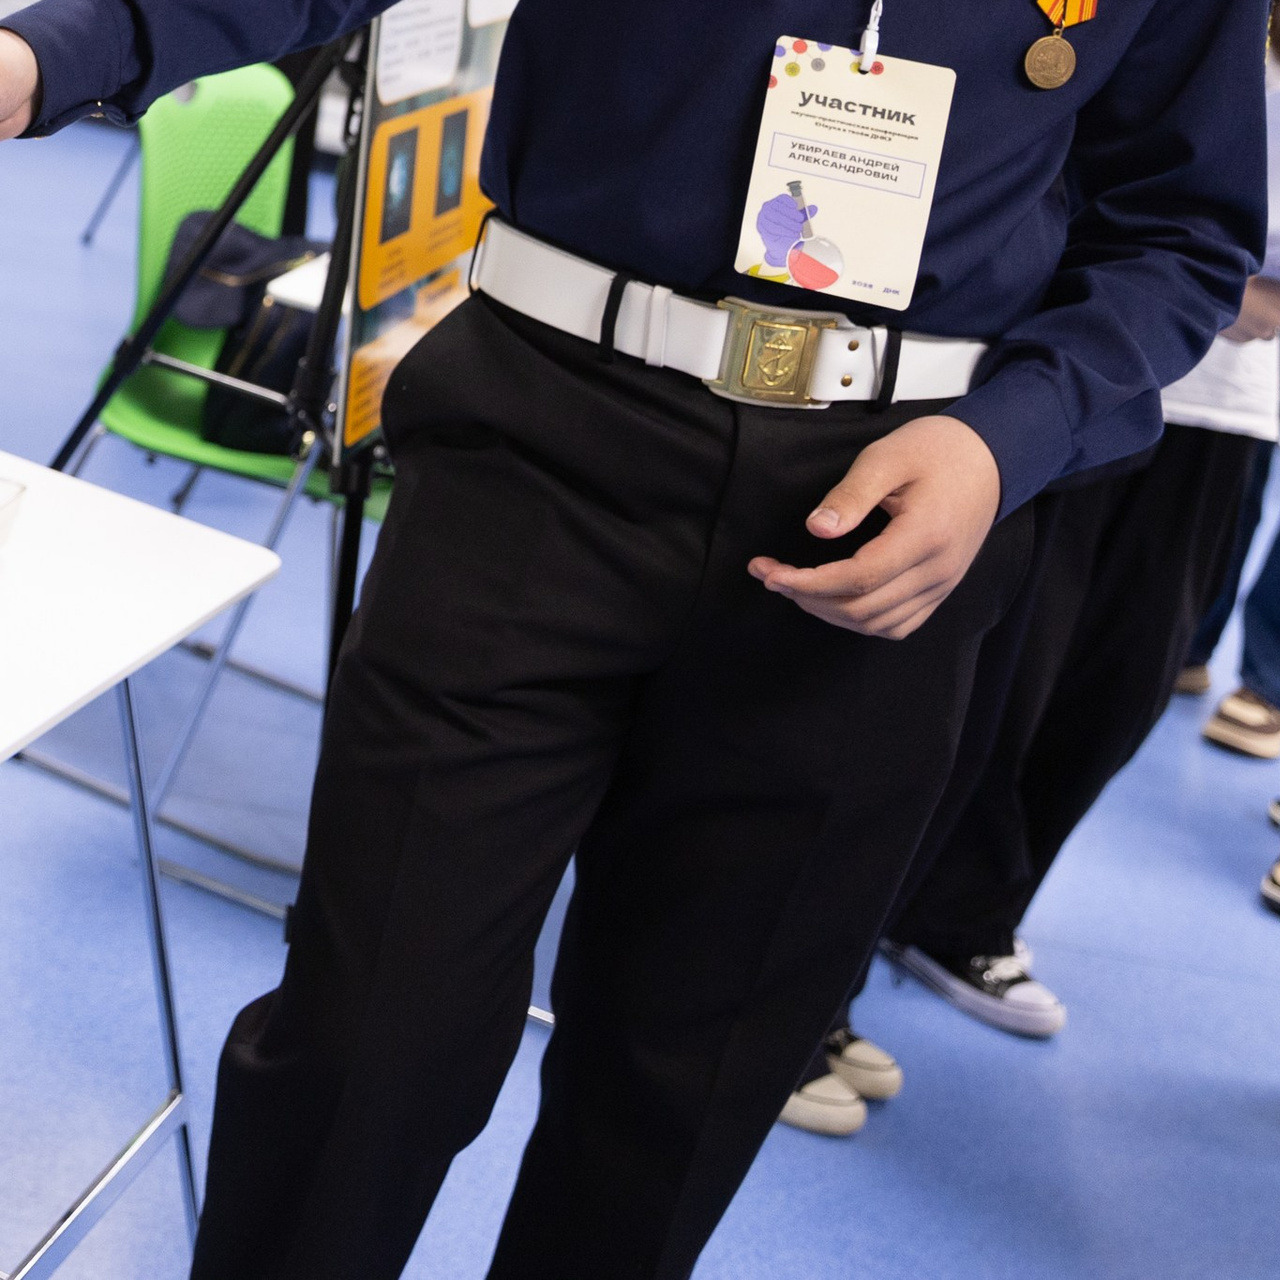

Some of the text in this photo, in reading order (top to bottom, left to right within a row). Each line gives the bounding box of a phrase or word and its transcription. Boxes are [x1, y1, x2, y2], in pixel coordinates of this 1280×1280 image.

[798, 91, 917, 126] участник
[788, 152, 898, 183] АЛЕКСАНДРОВИЧ
[791, 141, 900, 173] УБИРАЕВ АНДРЕЙ
